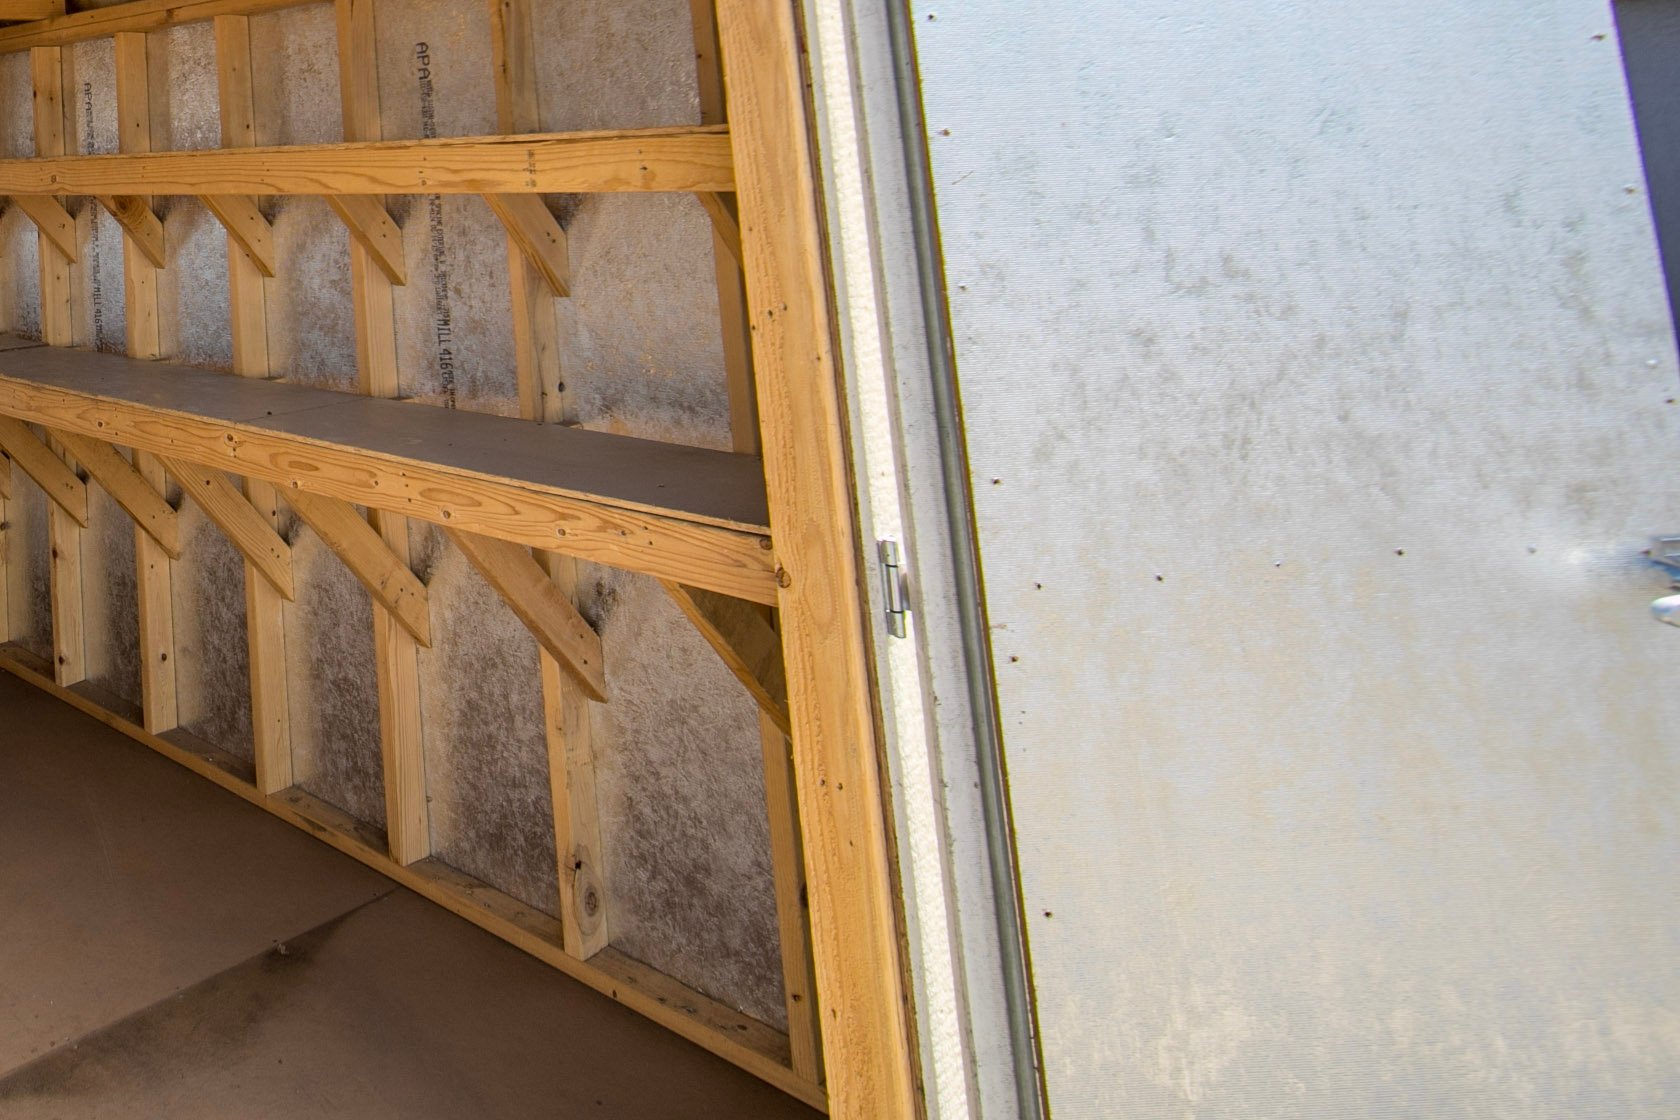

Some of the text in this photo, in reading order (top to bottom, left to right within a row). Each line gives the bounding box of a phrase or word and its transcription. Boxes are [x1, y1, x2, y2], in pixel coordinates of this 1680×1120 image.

[416, 42, 431, 80] APA
[84, 82, 93, 111] APA
[95, 308, 103, 324] 416
[436, 318, 452, 346] MILL
[439, 349, 454, 370] 416
